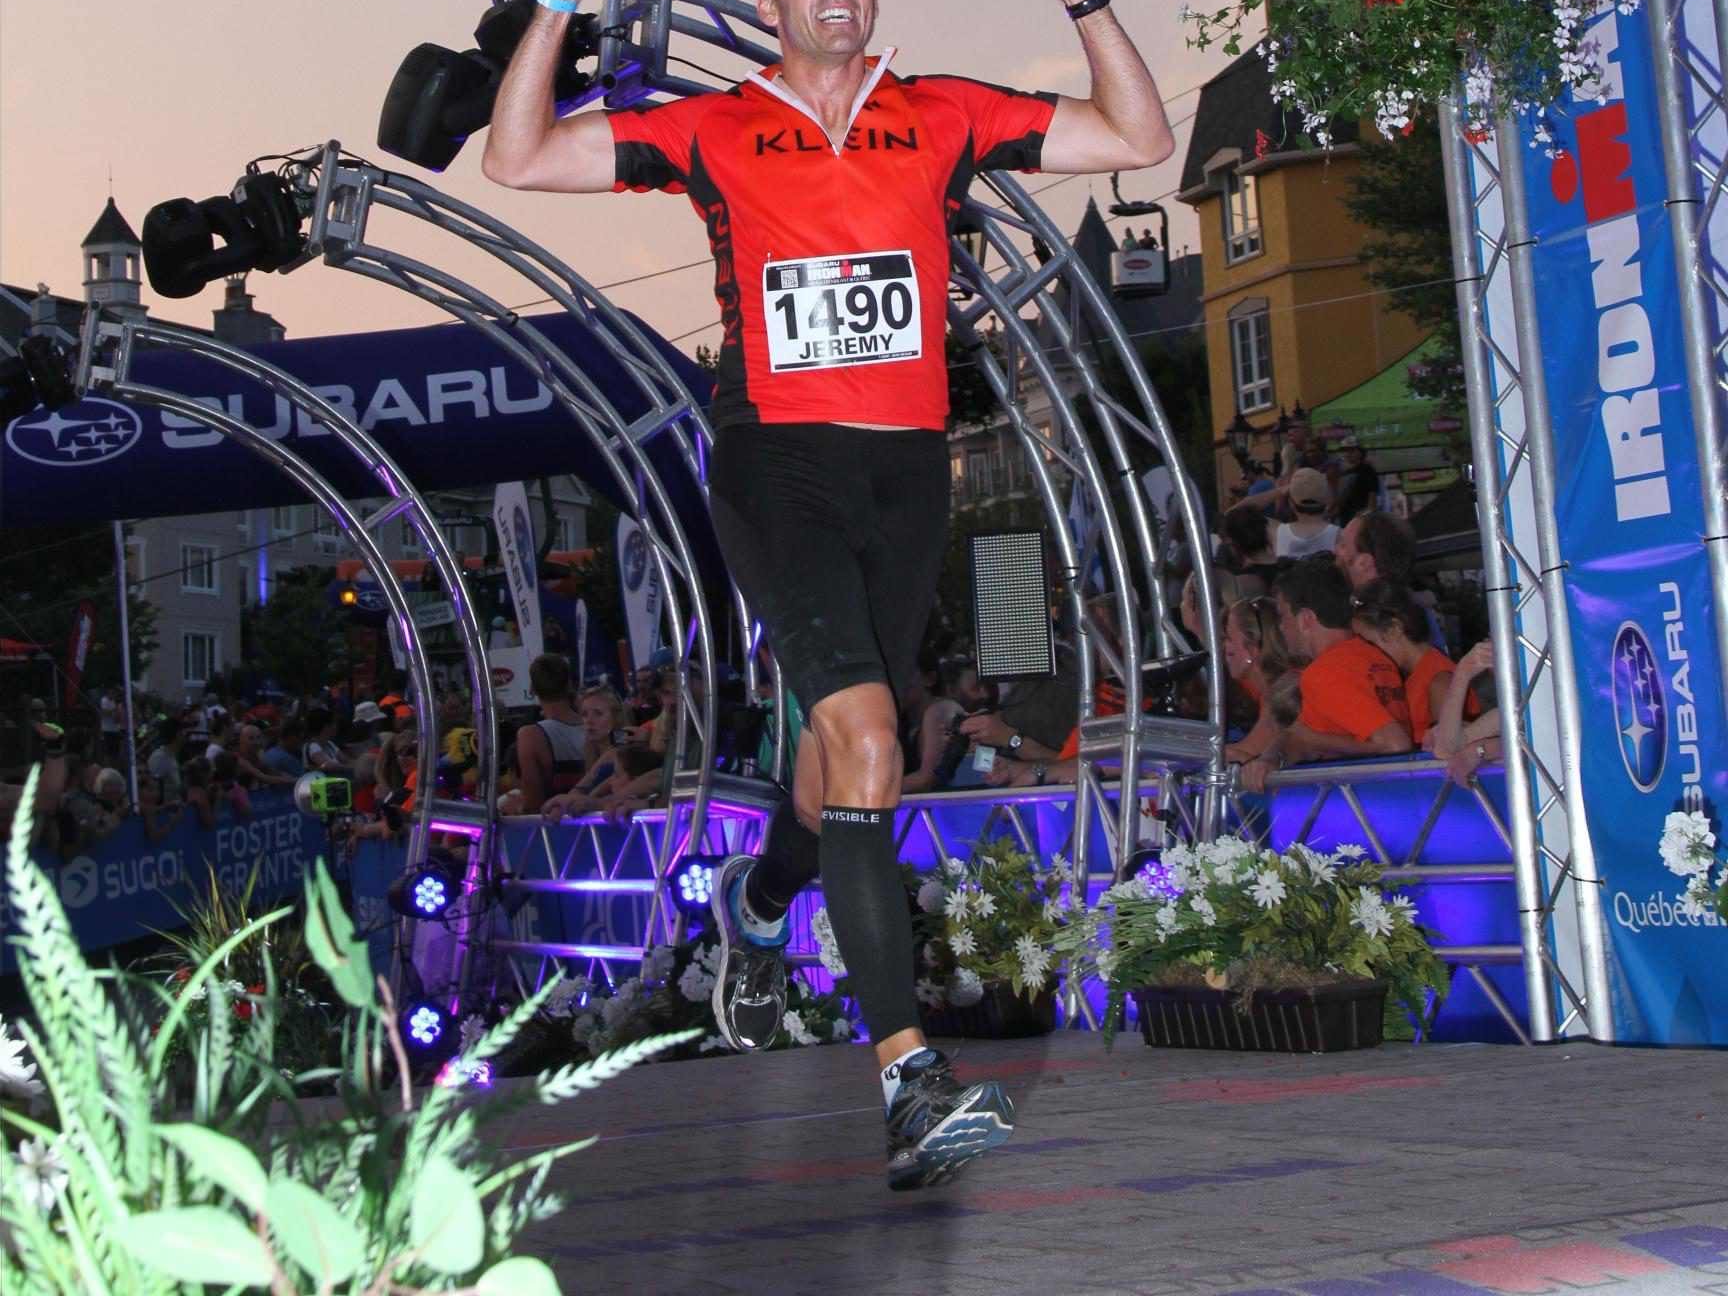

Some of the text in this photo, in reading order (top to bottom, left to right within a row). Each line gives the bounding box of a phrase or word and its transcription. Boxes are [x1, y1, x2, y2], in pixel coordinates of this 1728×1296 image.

[755, 127, 919, 156] KLEIN
[775, 281, 913, 341] 1490
[799, 333, 894, 360] JEREMY
[160, 366, 555, 449] SUBARU
[1658, 581, 1703, 813] SUBARU
[216, 813, 302, 857] FOSTER
